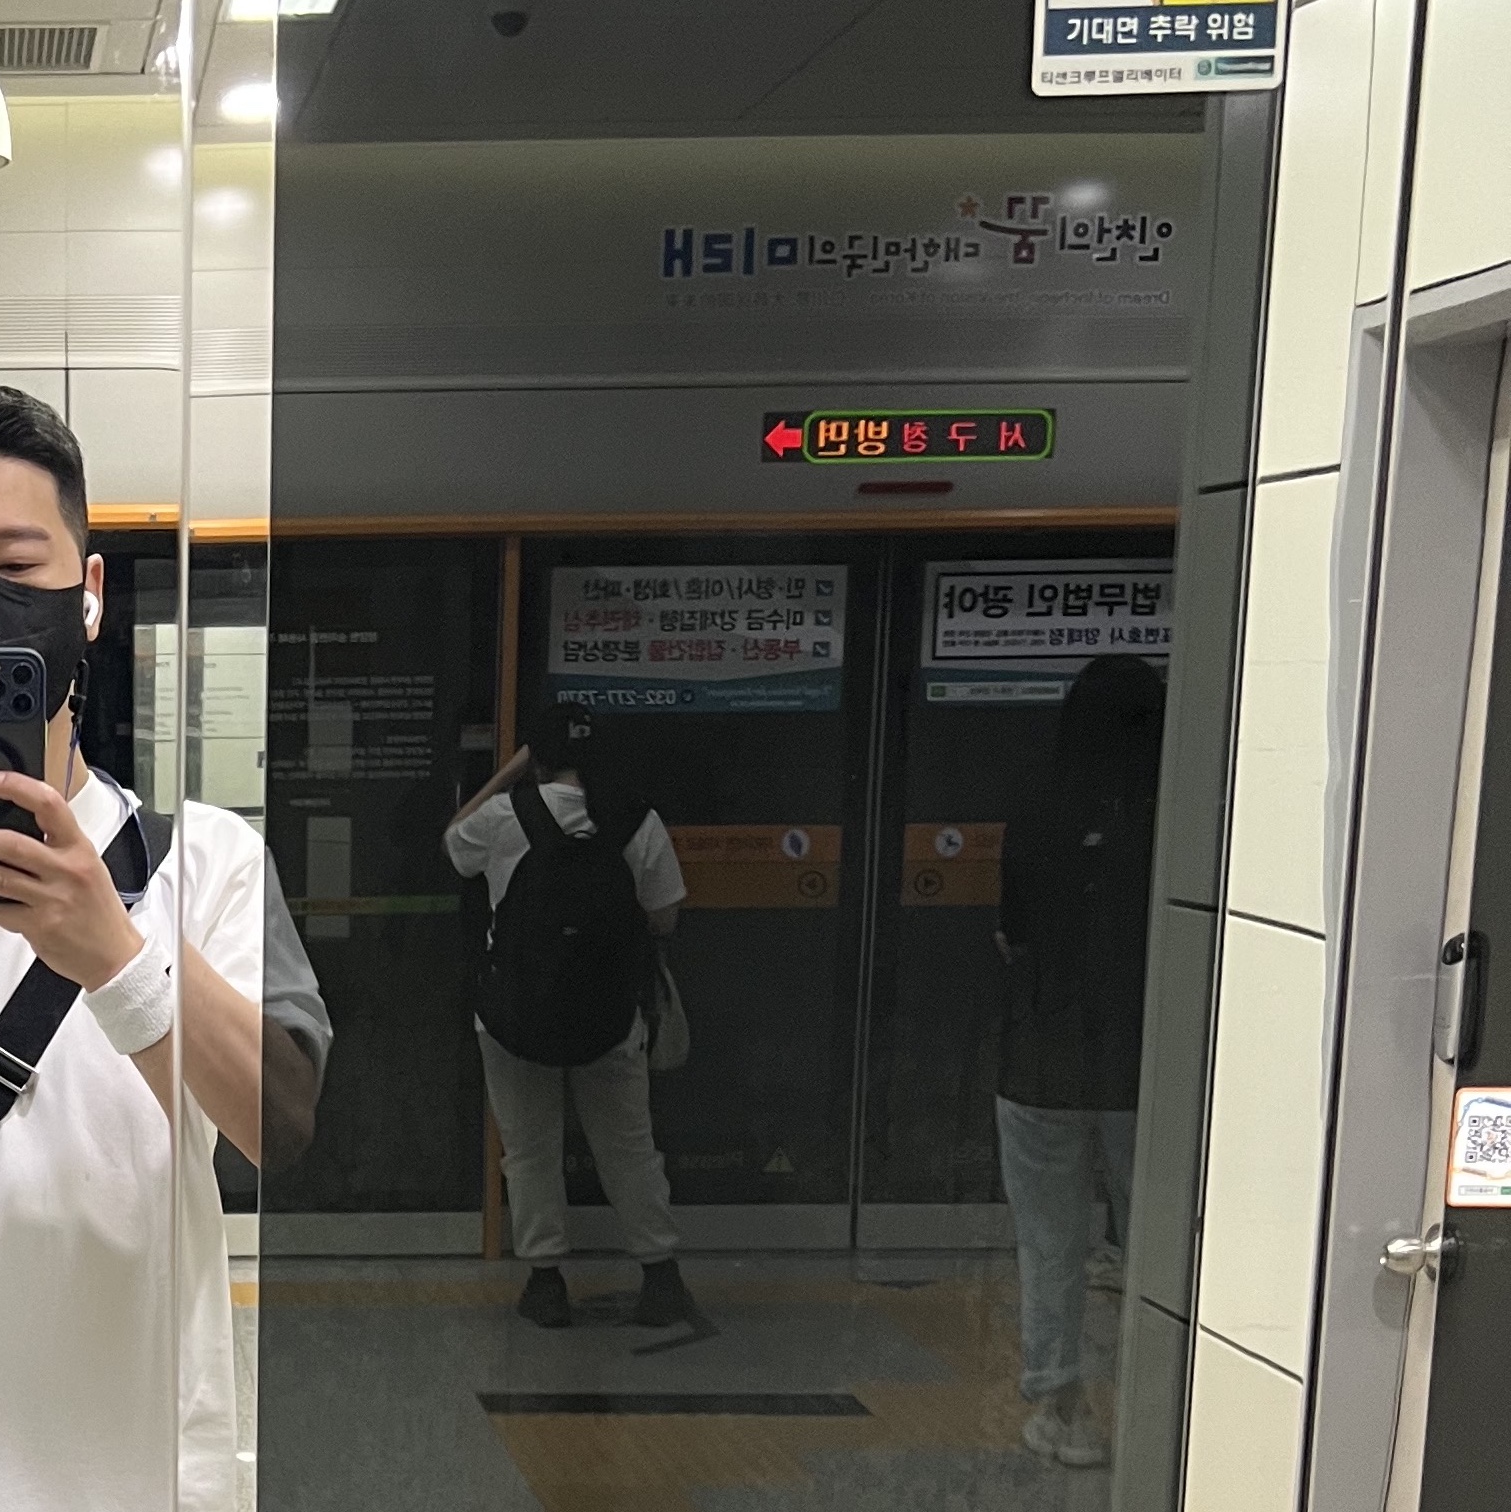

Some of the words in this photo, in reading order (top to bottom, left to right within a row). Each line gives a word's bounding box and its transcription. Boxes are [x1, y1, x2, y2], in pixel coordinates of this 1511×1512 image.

[1067, 17, 1138, 44] 기대면
[1149, 15, 1199, 42] 추락
[1207, 13, 1254, 41] 위험
